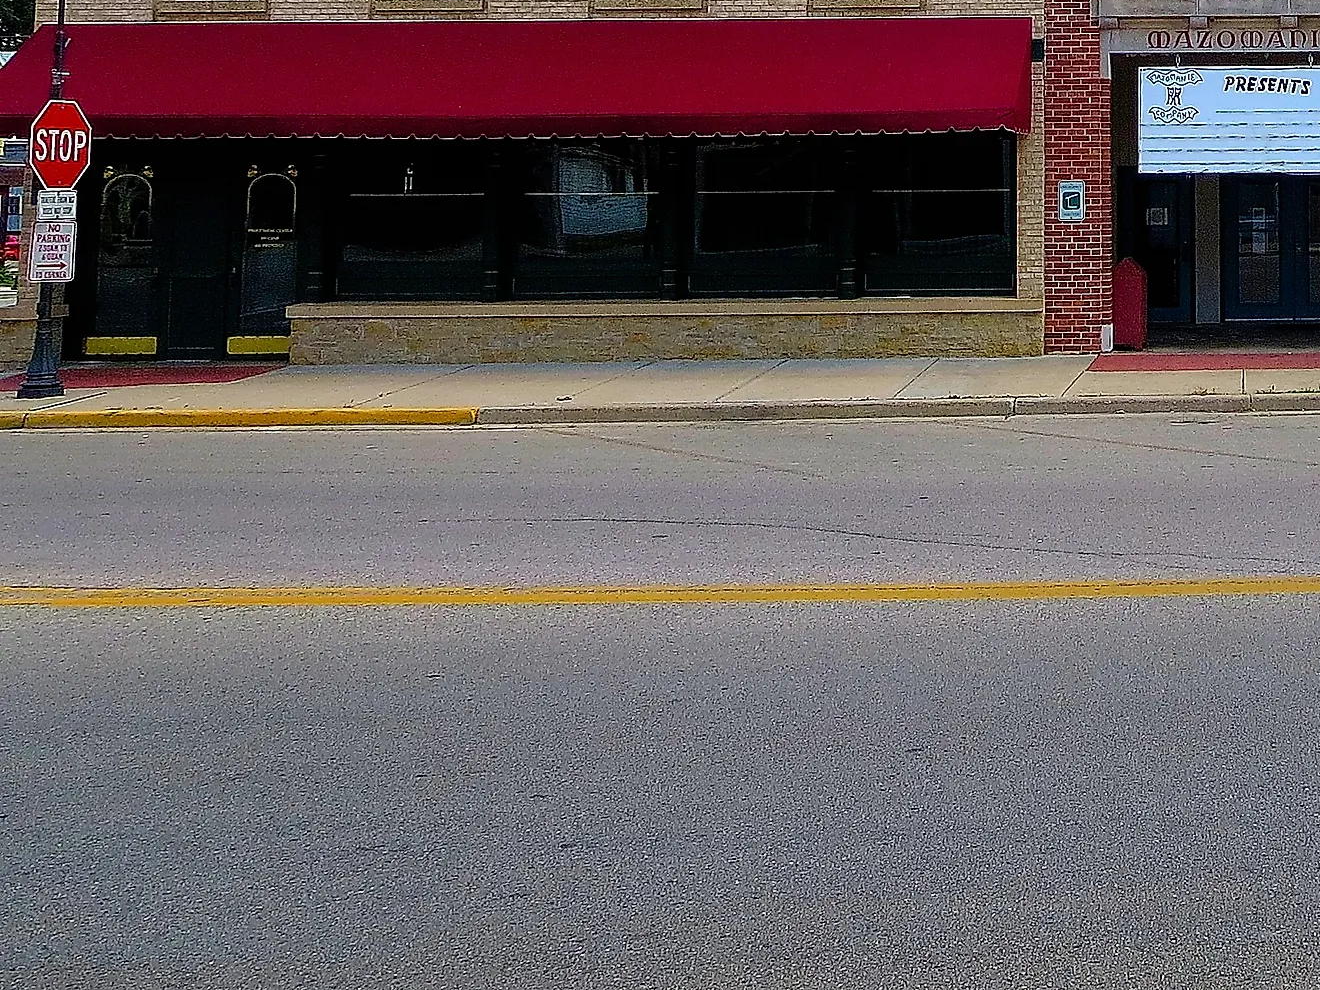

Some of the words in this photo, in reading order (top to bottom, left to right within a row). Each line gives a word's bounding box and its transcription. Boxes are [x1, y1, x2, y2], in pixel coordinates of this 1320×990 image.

[1224, 76, 1310, 94] PRESENTS
[35, 129, 87, 161] STOP
[48, 224, 60, 232] NO
[37, 234, 70, 243] PARKING
